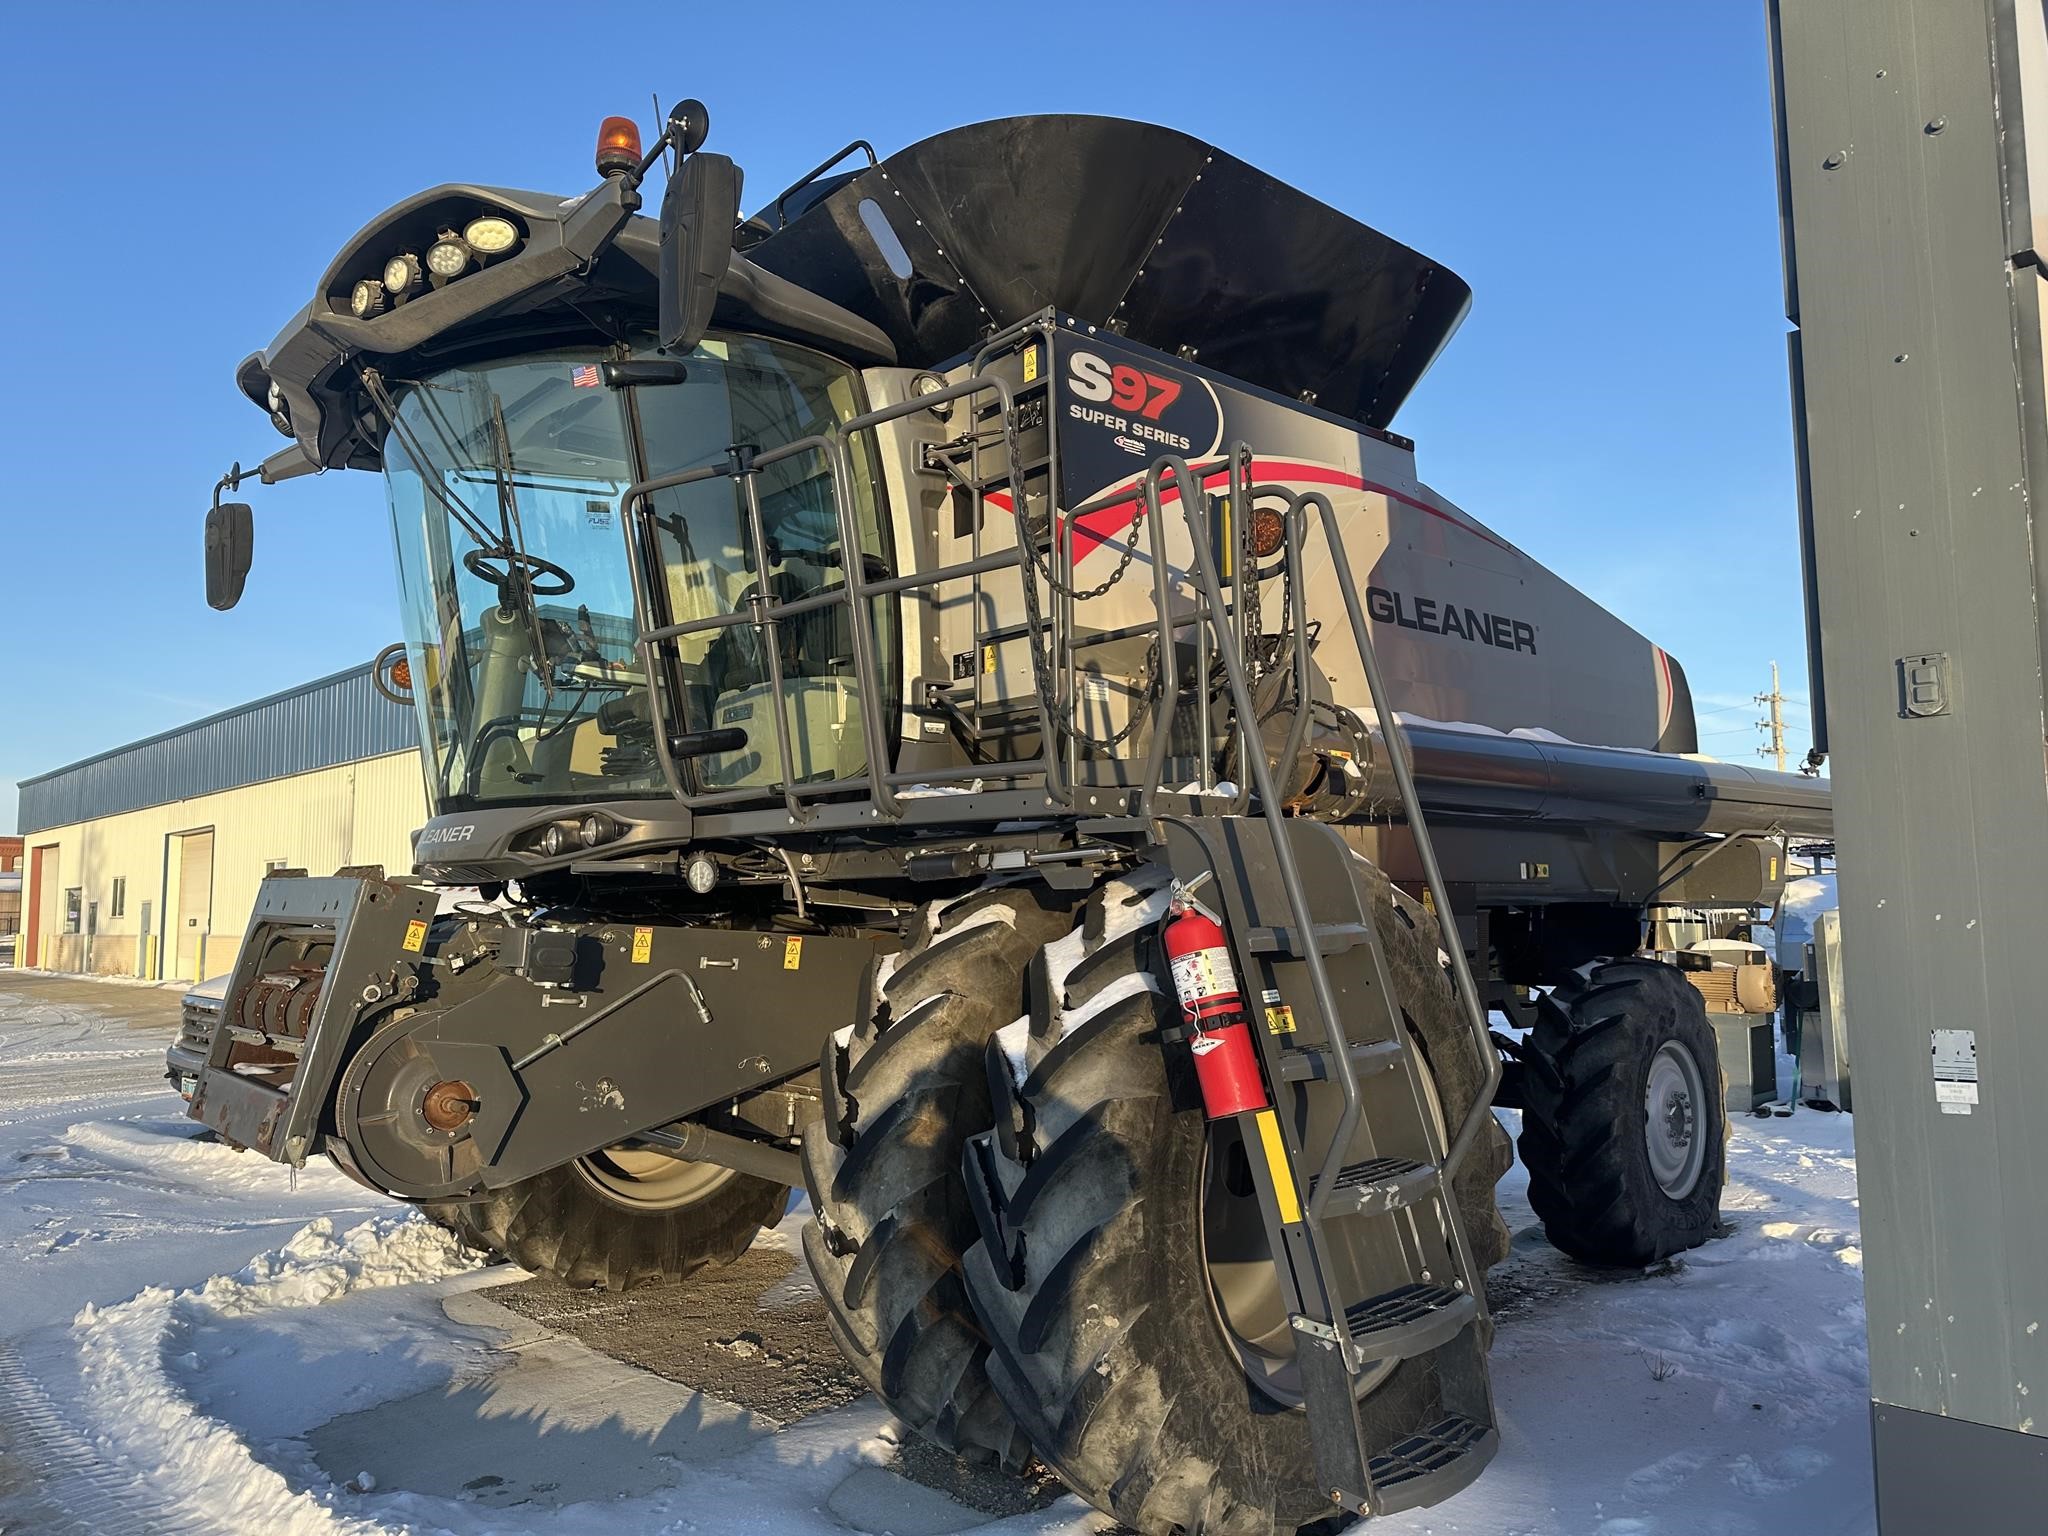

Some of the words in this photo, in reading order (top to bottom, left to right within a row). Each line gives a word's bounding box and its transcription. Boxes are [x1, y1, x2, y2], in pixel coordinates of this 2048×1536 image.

[1068, 351, 1182, 420] S97
[1069, 404, 1127, 432] SUPER
[1132, 422, 1191, 450] SERIES
[1365, 586, 1537, 655] GLEANER
